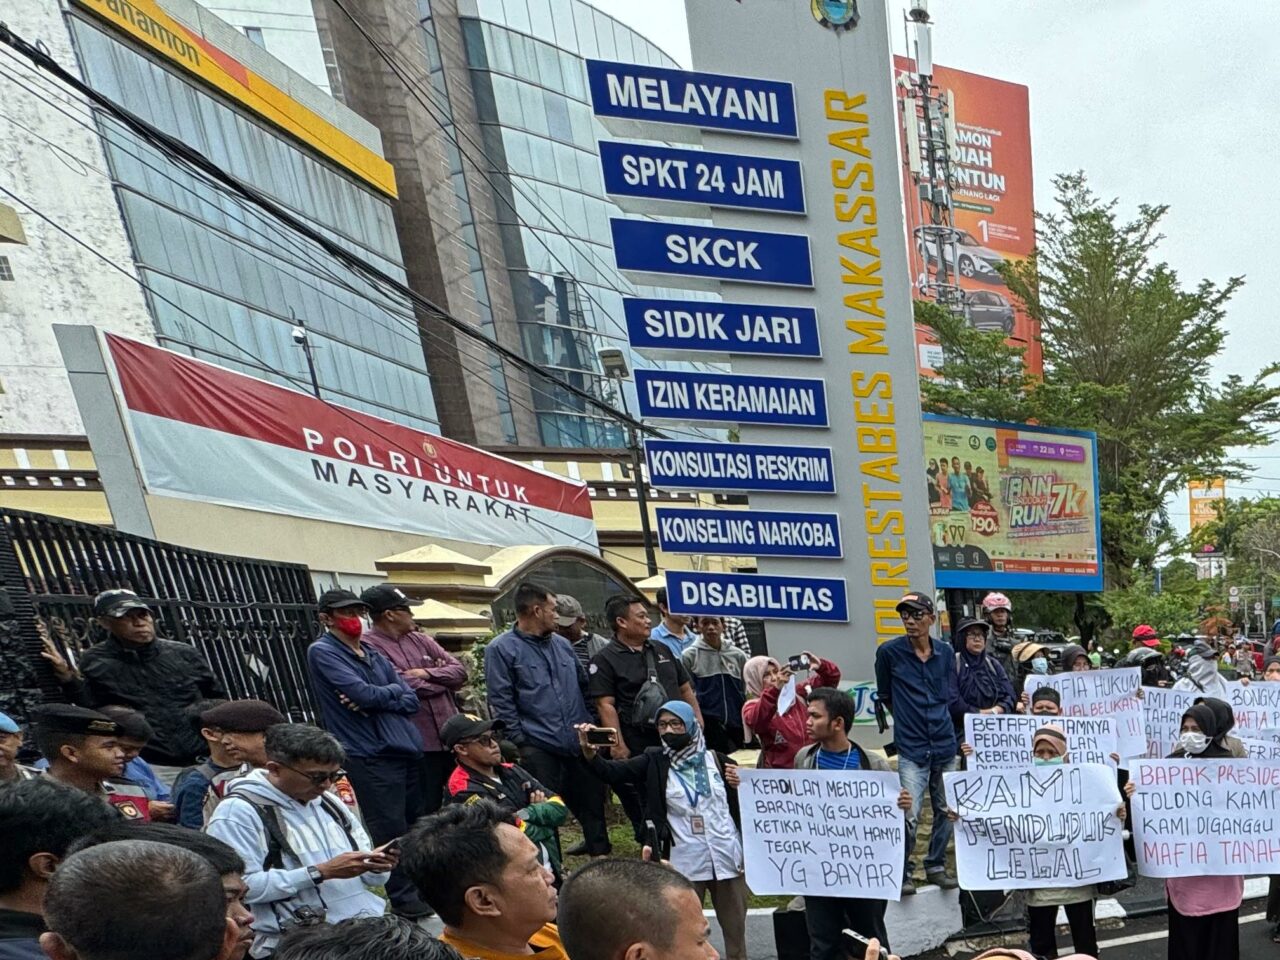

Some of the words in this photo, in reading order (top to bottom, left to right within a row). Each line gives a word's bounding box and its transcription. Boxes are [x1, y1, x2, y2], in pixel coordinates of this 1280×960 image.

[95, 0, 200, 67] anamon
[606, 74, 779, 124] MELAYANI
[622, 155, 688, 190] SPKT
[696, 163, 725, 193] 24
[732, 166, 784, 199] JAM
[823, 88, 889, 355] MAKASSAR
[665, 234, 762, 270] SKCK
[644, 309, 728, 341] SIDIK
[735, 314, 802, 344] JARI
[647, 380, 689, 410] IZIN
[694, 383, 816, 416] KERAMAIAN
[303, 427, 422, 477] POLRI
[434, 462, 530, 503] UNTUK
[650, 450, 752, 479] KONSULTASI
[756, 454, 829, 482] RESKRIM
[311, 458, 531, 523] MASYARAKAT
[1009, 476, 1053, 498] BNN
[852, 371, 910, 646] OLRESTABES
[1011, 504, 1048, 527] RUN
[661, 516, 754, 545] KONSELING
[759, 520, 836, 547] NARKOBA
[681, 580, 833, 612] DISABILITAS
[1094, 674, 1140, 698] HUKUM
[972, 717, 1037, 732] BETAPA
[974, 733, 1026, 748] PEDANG
[751, 778, 821, 798] KEADILAN
[826, 780, 885, 798] MENJADI
[1140, 764, 1212, 786] BAPAK
[954, 768, 1082, 817] KAMI
[1138, 790, 1213, 811] TOLONG
[1226, 789, 1276, 811] KAMI
[755, 800, 814, 818] BARANG
[818, 802, 836, 822] YG
[838, 804, 897, 819] SUKAR
[1143, 817, 1189, 836] KAMI
[1197, 816, 1273, 835] DIGANGGU
[753, 819, 802, 833] KETIKA
[808, 822, 859, 841] HUKUM
[863, 825, 901, 847] HANYA
[962, 811, 1116, 846] PENDUDUK
[764, 840, 817, 855] TEGAK
[829, 842, 874, 860] PADA
[987, 847, 1101, 880] LEGAL
[1144, 840, 1208, 868] MAFIA
[768, 856, 808, 888] YG
[821, 861, 898, 889] BAYAR
